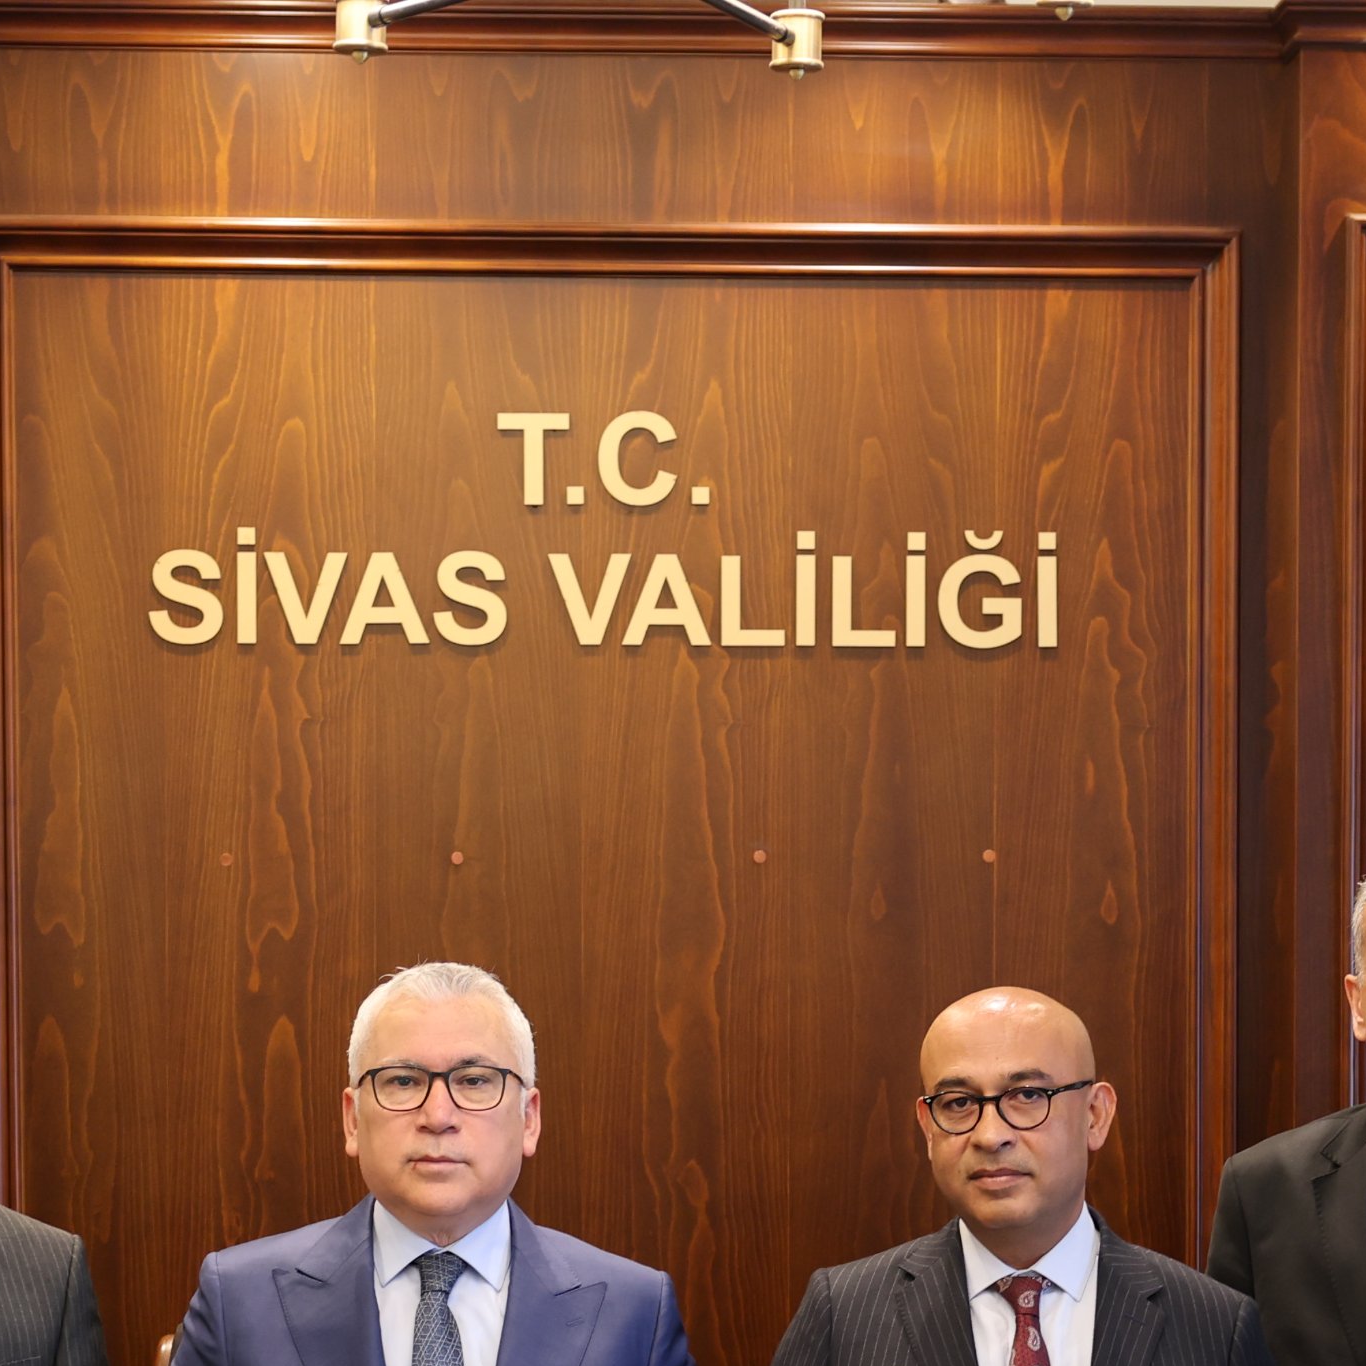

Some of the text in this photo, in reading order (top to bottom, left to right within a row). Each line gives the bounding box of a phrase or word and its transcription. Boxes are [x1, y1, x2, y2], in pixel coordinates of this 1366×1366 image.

[497, 410, 711, 507] T.C.
[147, 526, 1058, 650] SİVAS VALİLİĞİ
